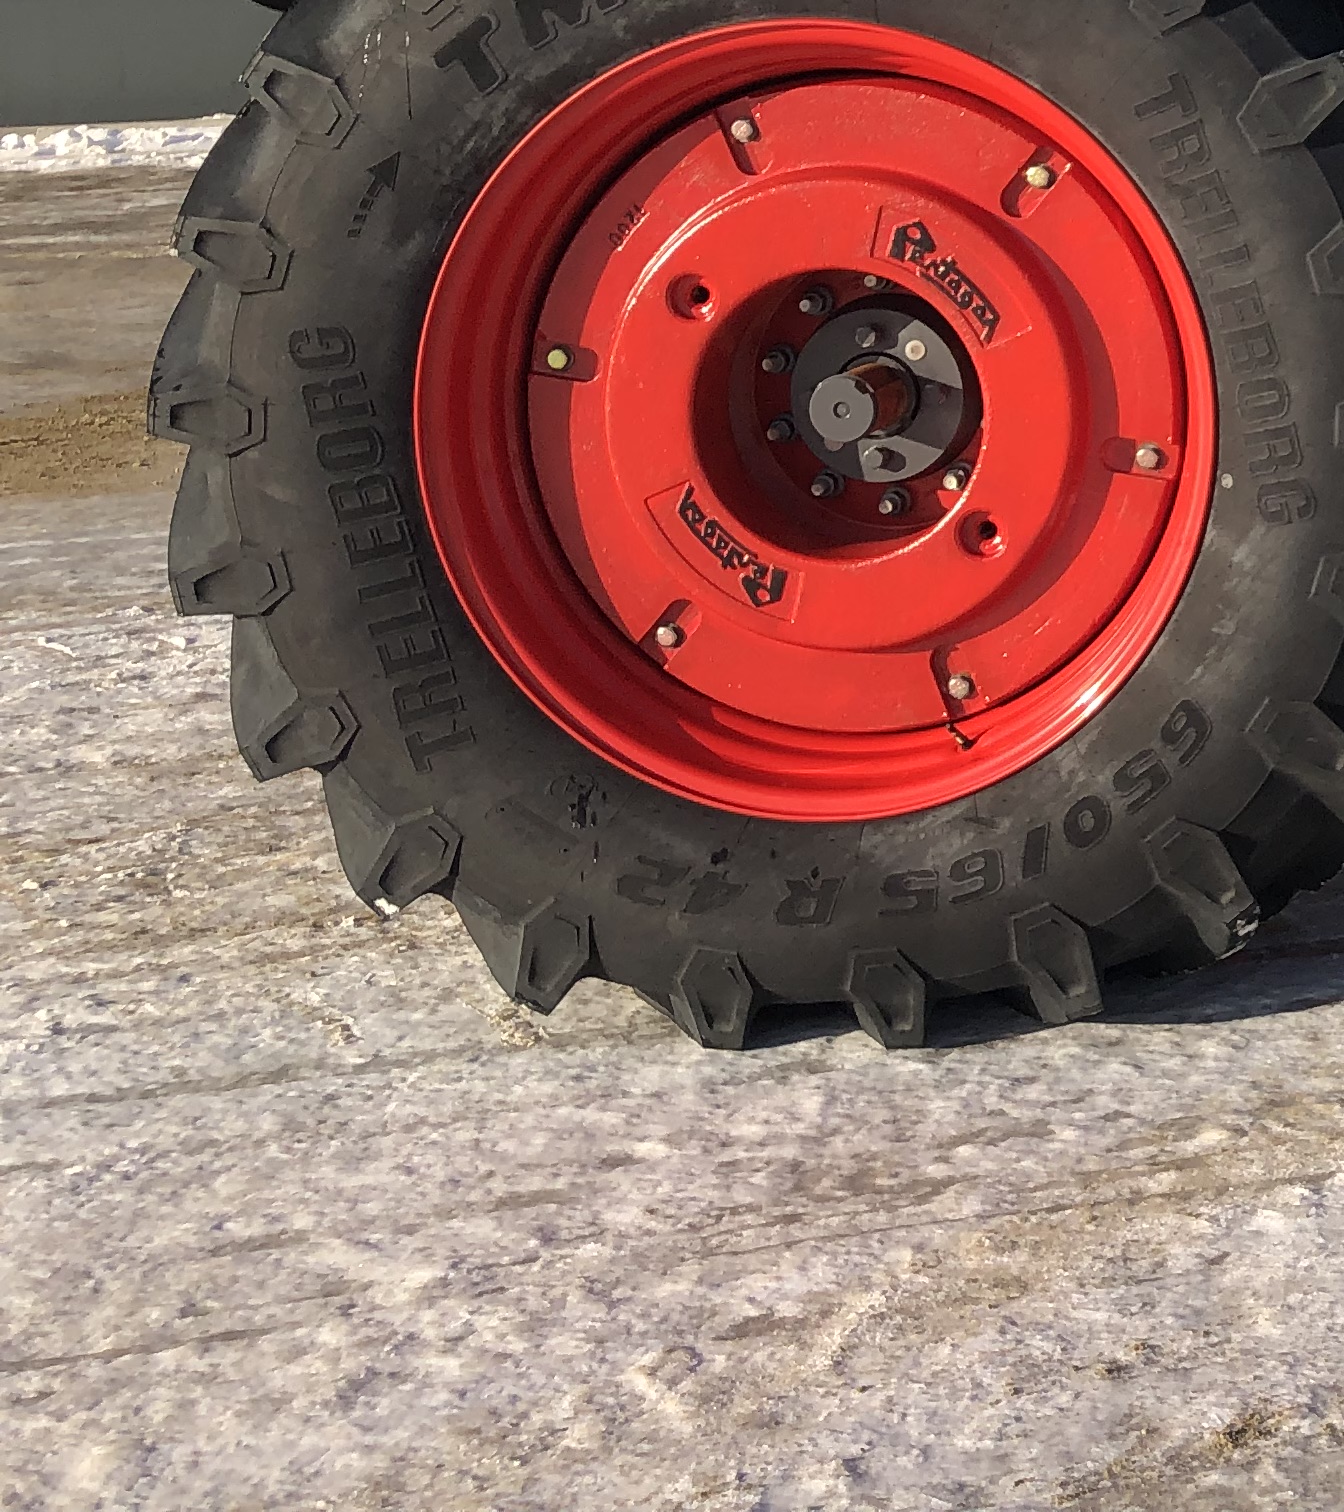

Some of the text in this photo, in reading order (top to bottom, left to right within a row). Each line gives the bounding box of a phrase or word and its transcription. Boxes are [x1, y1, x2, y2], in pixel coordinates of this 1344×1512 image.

[1133, 70, 1317, 527] TRELLEBORG
[288, 324, 477, 774] TRELLEBORG
[616, 854, 750, 915] 42
[773, 872, 846, 926] R
